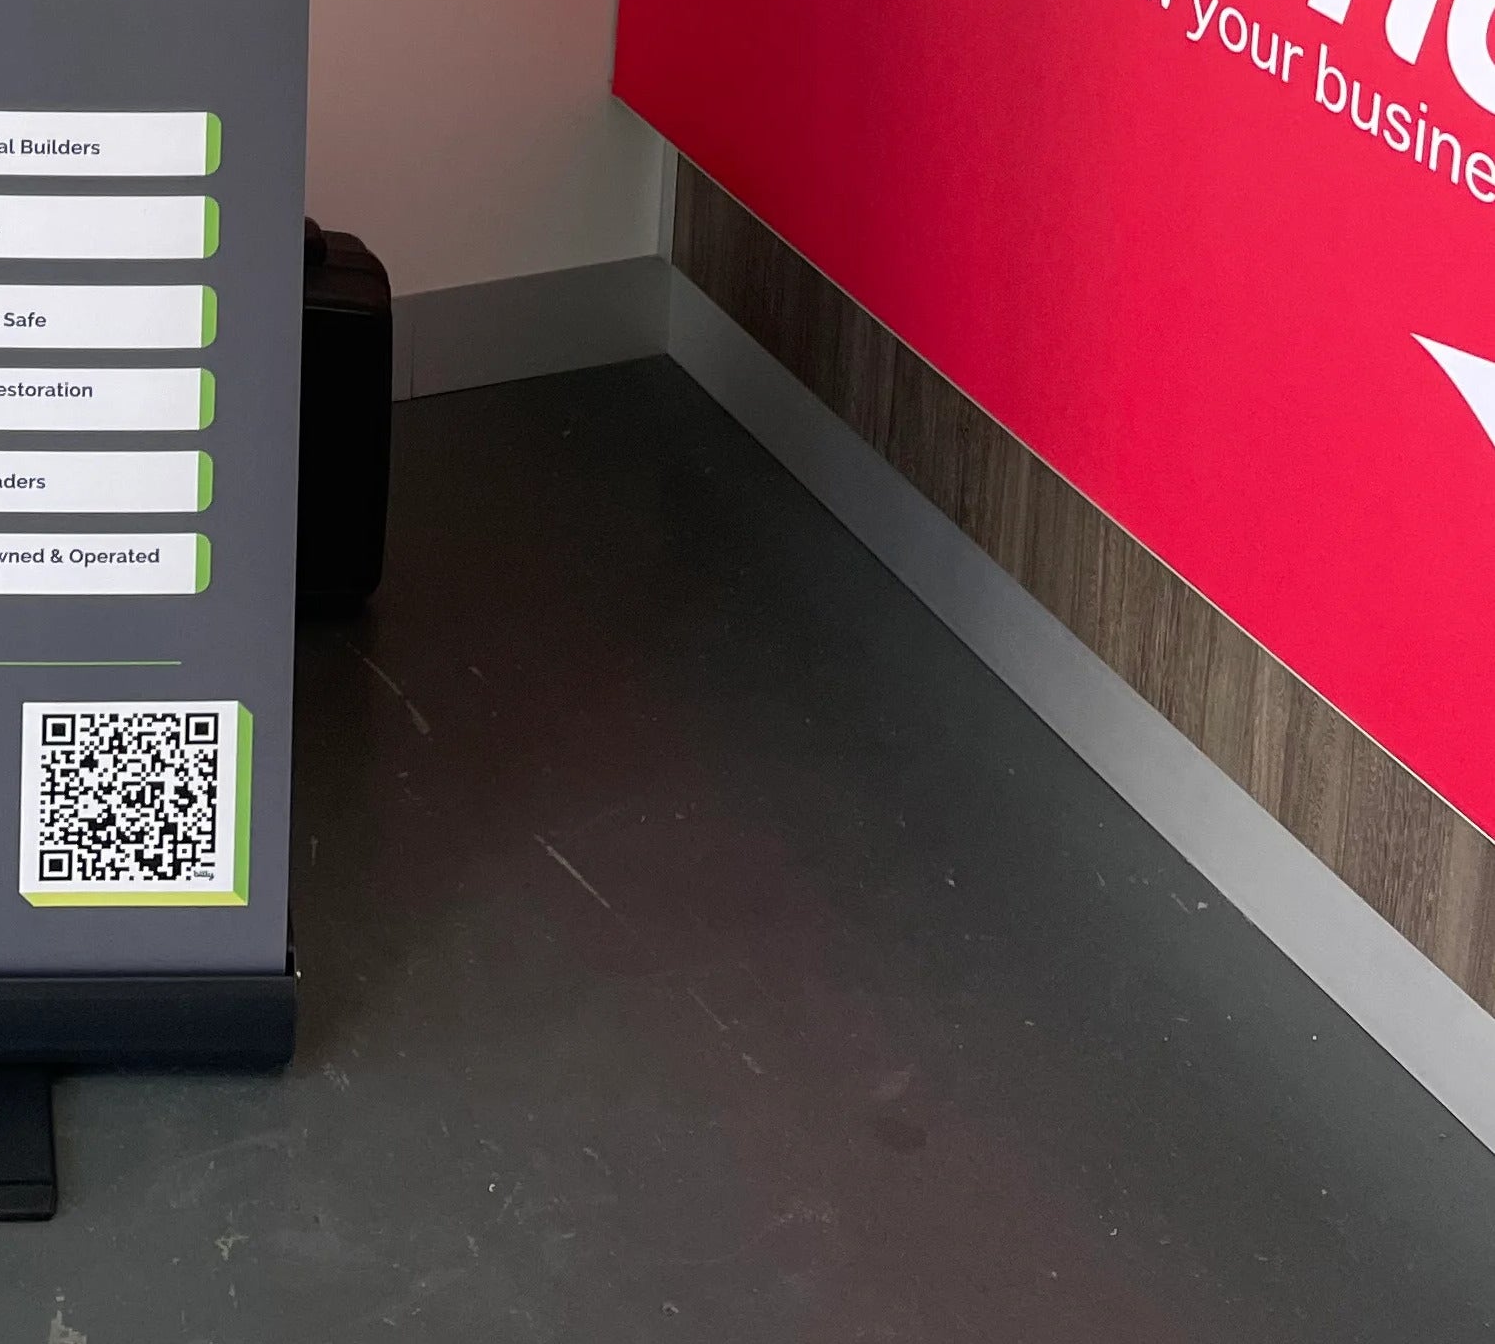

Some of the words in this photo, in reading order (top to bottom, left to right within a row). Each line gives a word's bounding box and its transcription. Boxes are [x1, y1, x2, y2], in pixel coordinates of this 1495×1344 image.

[1316, 42, 1495, 205] busine
[21, 140, 99, 154] Builders
[4, 312, 46, 327] Safe
[51, 549, 62, 563] &
[70, 549, 159, 567] Operated
